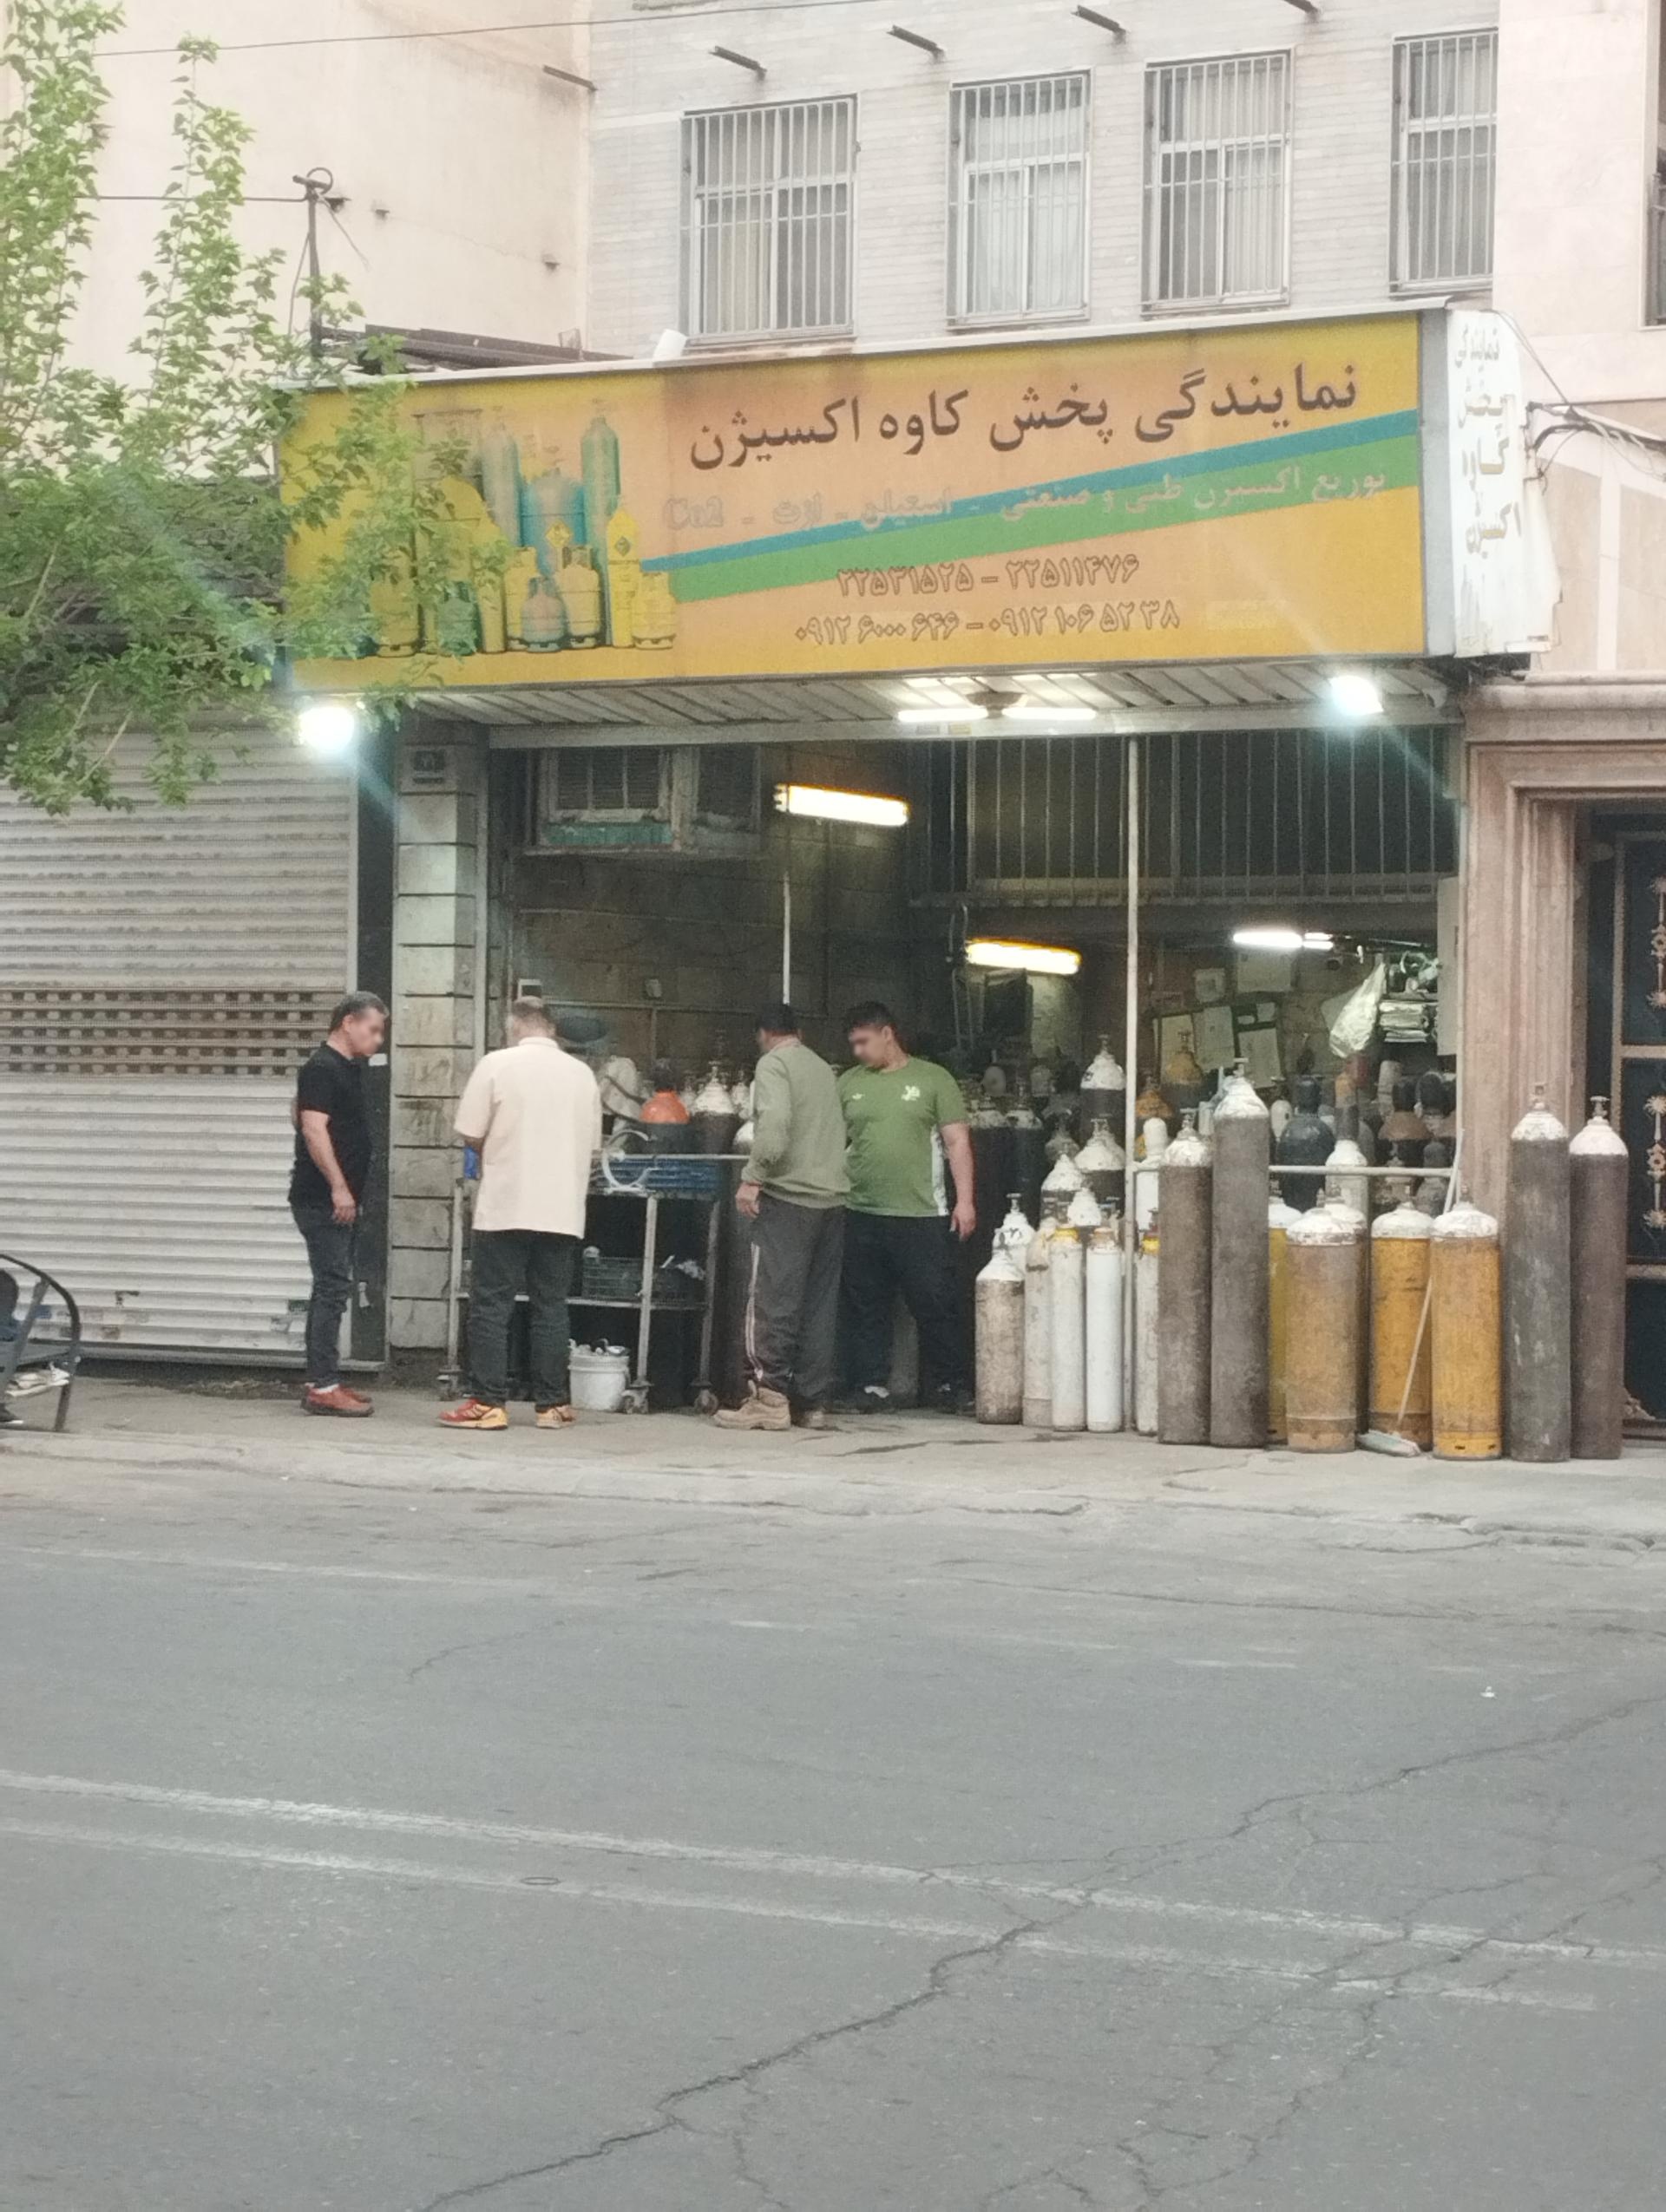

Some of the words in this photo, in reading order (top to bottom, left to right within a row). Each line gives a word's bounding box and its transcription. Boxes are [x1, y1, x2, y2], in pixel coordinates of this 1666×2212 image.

[690, 396, 860, 470] اکسیژن
[879, 389, 969, 455] کاوه
[989, 382, 1113, 451] پخش
[1134, 363, 1357, 442] نمایندگی
